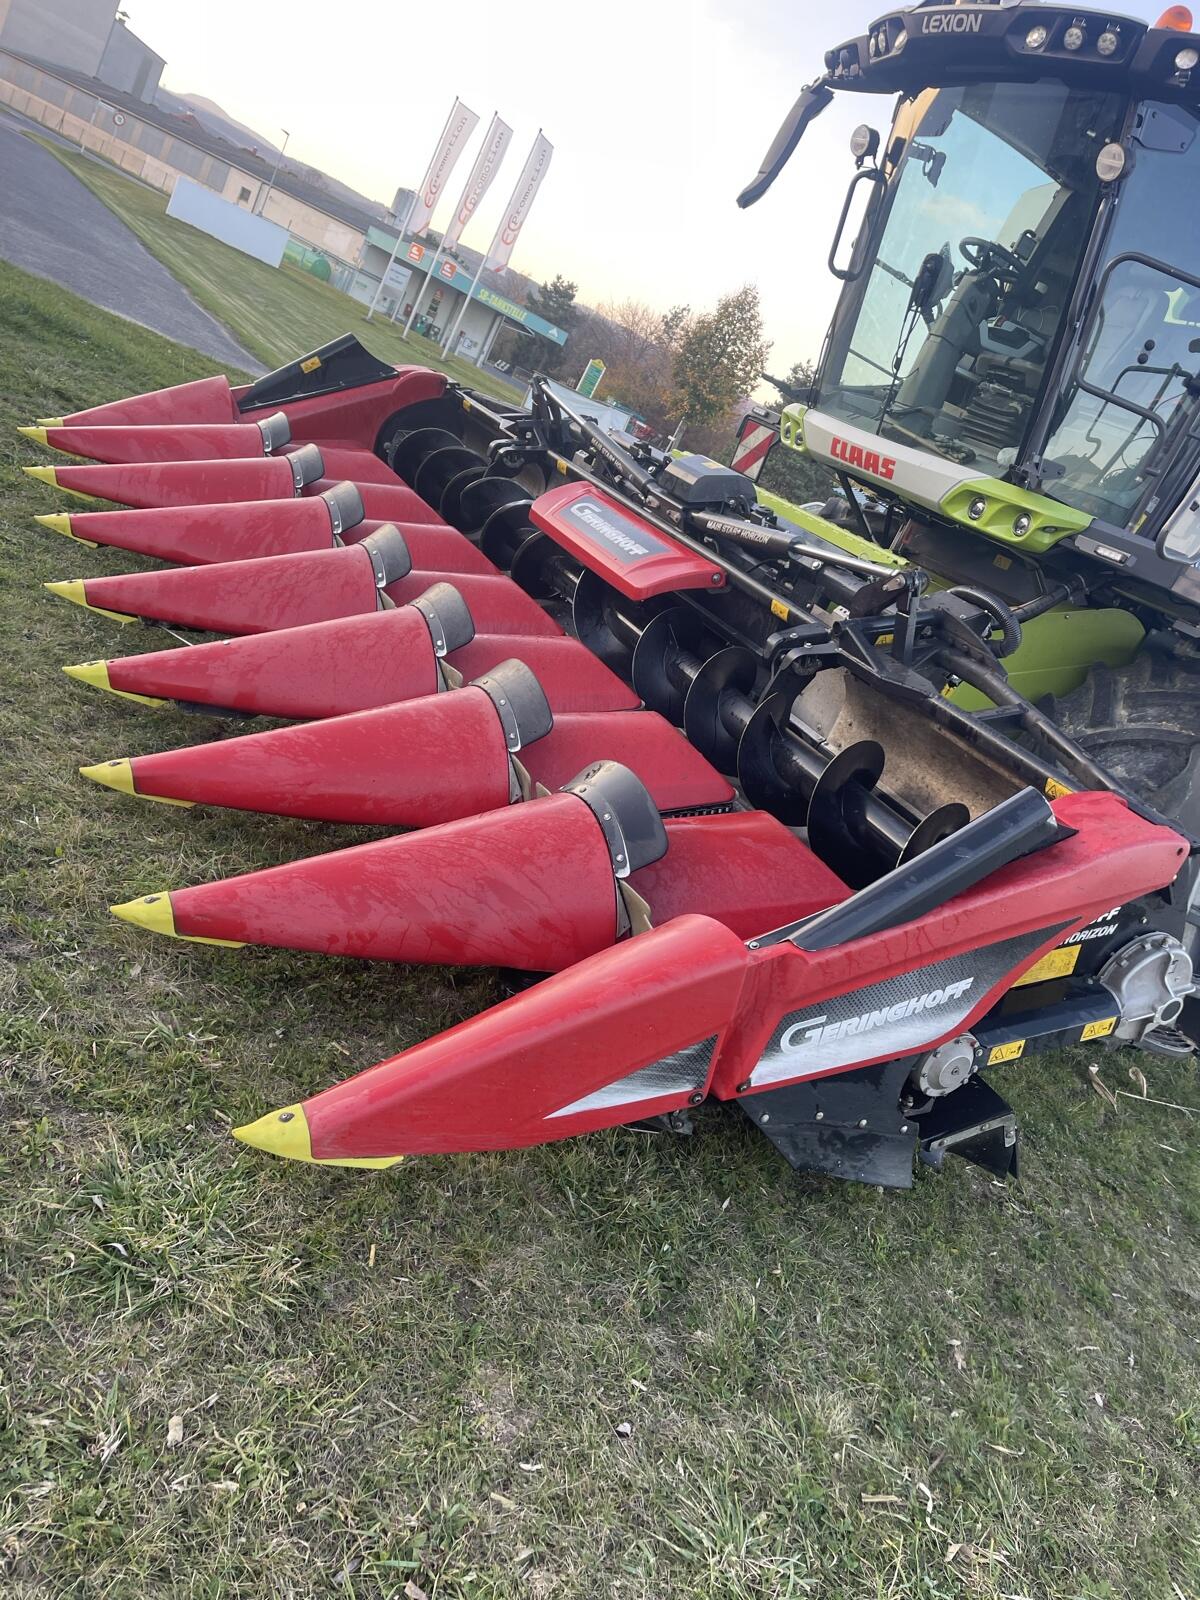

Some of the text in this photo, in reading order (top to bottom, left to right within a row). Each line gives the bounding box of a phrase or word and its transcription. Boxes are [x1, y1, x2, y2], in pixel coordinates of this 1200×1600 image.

[922, 13, 983, 34] LEXION
[830, 436, 897, 481] CLAAS
[570, 503, 649, 555] GERINGHOFF
[740, 529, 772, 544] HORIZON
[780, 977, 974, 1054] GERINGHOFF
